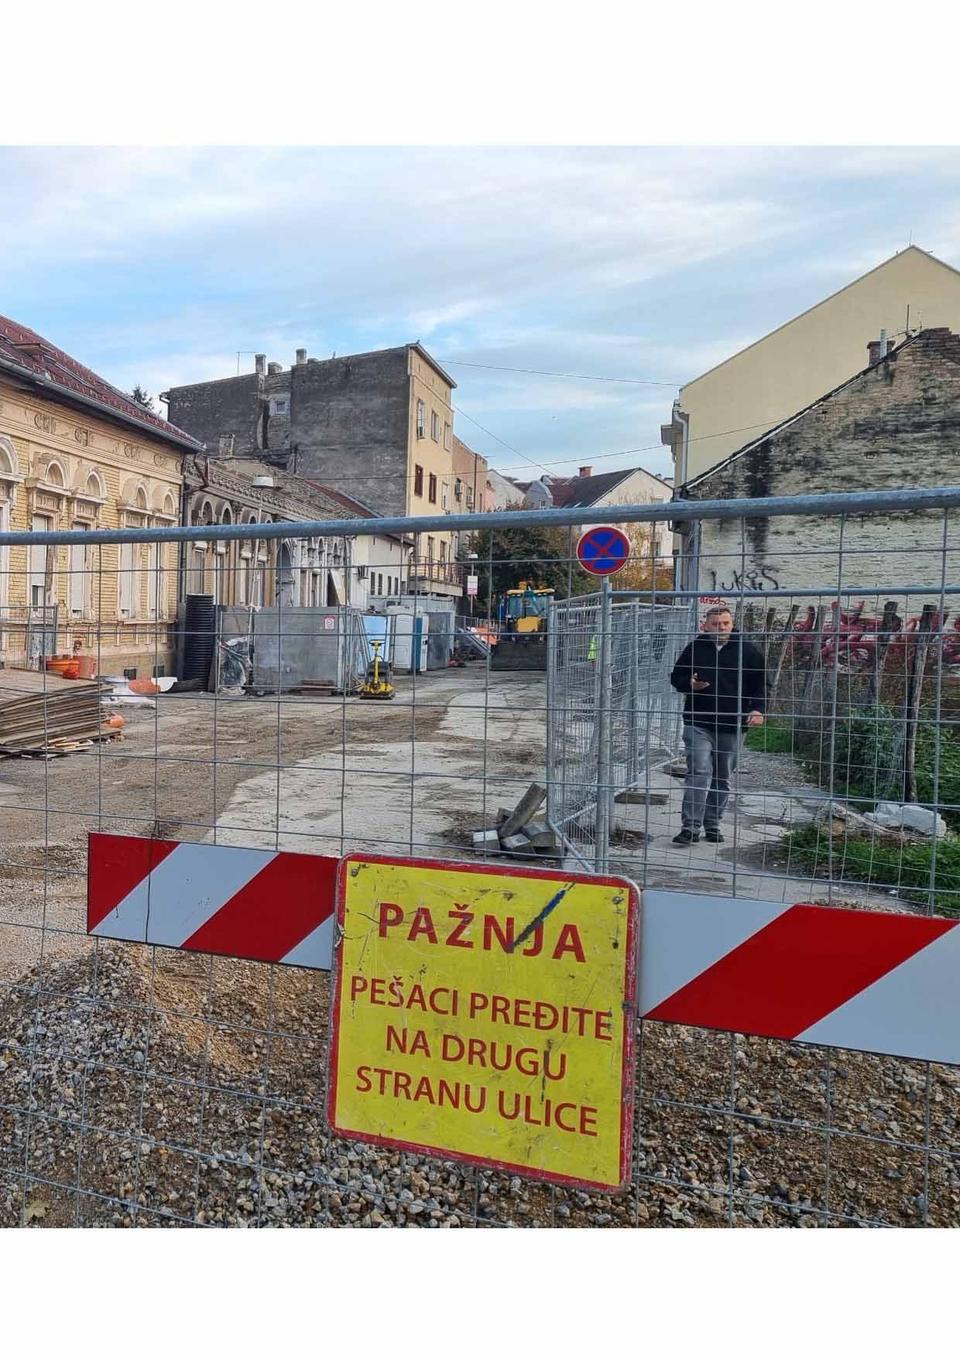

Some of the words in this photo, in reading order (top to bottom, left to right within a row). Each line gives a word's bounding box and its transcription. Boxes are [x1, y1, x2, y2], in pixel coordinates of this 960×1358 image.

[379, 903, 586, 963] PAŽNJA
[351, 975, 458, 1016] PEŠACI
[470, 992, 613, 1041] PREĐITE
[386, 1025, 431, 1058] NA
[442, 1034, 567, 1081] DRUGU
[356, 1065, 486, 1114] STRANU
[498, 1090, 598, 1137] ULICE
